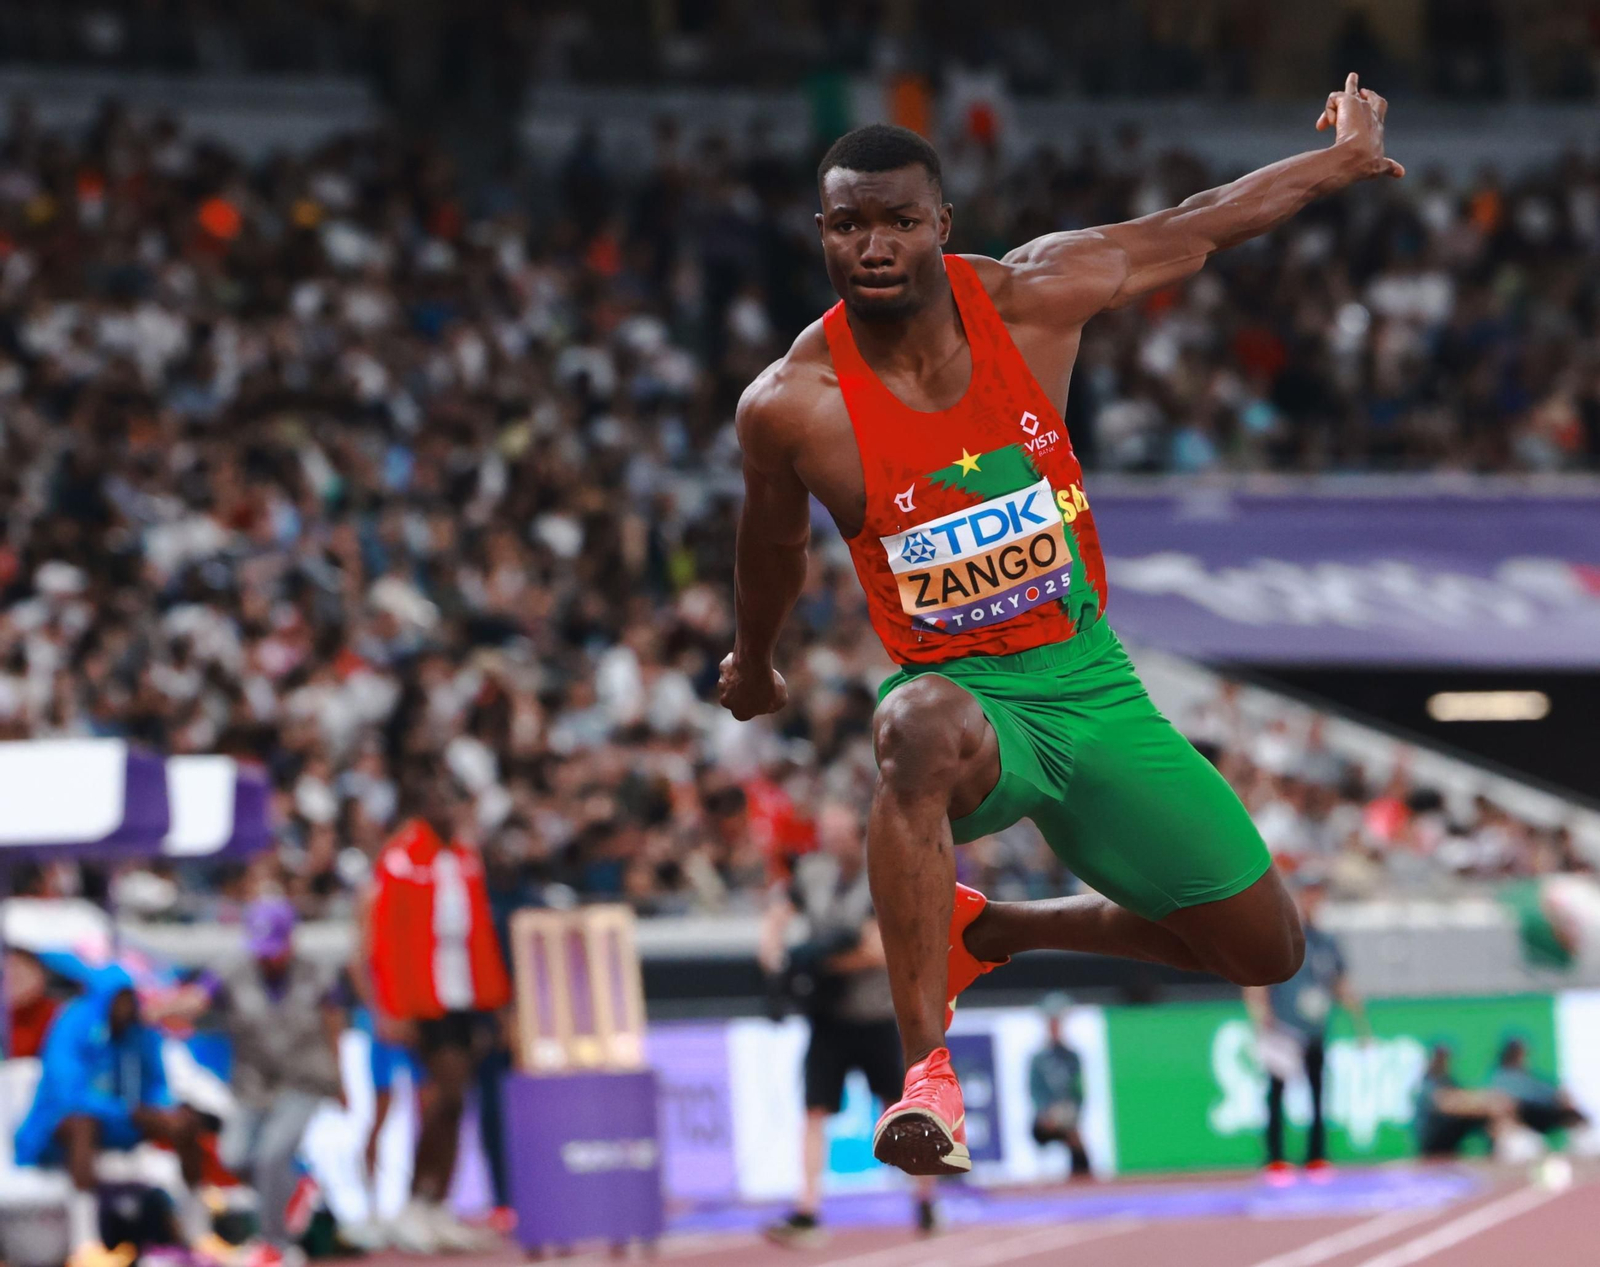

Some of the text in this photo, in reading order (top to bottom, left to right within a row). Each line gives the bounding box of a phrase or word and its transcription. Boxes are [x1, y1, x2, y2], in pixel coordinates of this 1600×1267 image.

[1024, 430, 1060, 453] VISTA
[931, 490, 1048, 556] TDK
[908, 533, 1057, 609] ZANGO
